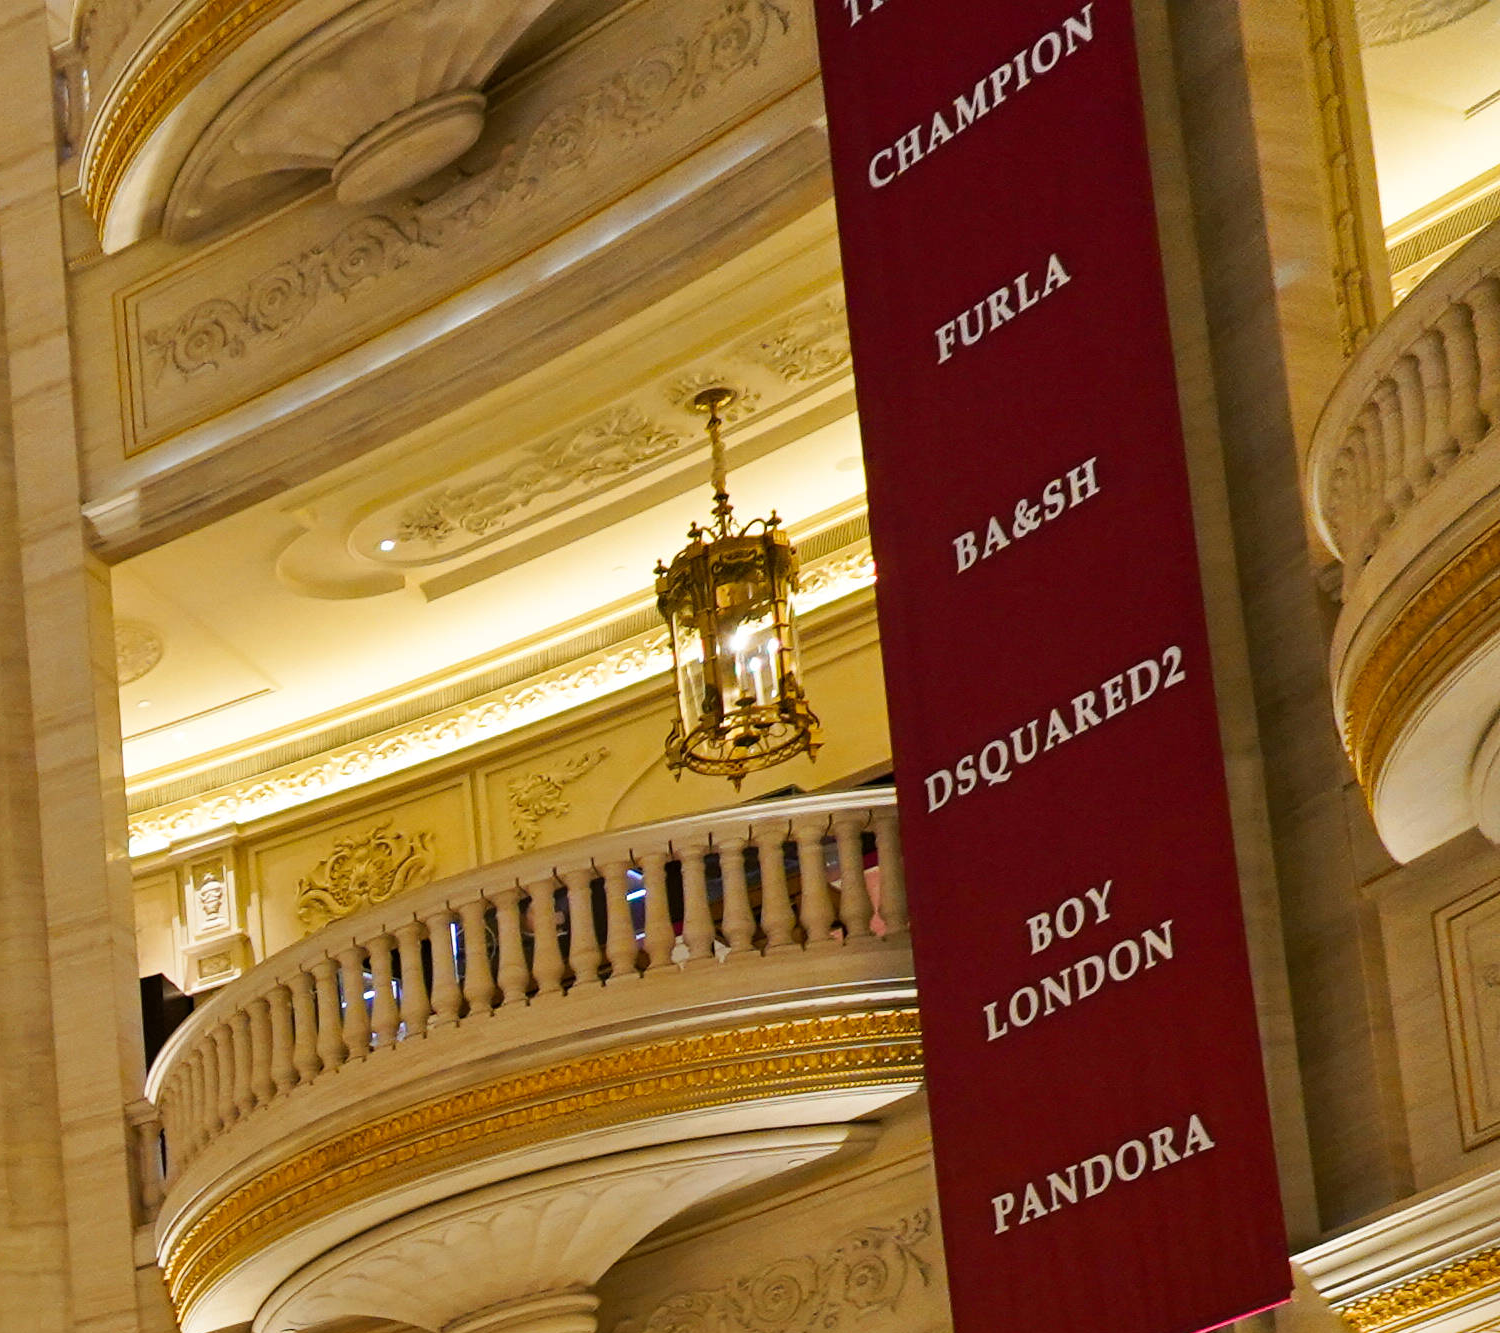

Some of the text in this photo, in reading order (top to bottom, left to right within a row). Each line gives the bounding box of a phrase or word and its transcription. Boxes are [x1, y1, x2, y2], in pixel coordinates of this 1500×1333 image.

[869, 5, 1093, 188] CHAMPION
[934, 254, 1071, 363] FURLA
[952, 456, 1100, 574] BA&SH
[924, 645, 1185, 813] DSQUARED2
[1026, 879, 1112, 955] BOY
[983, 919, 1173, 1042] LONDON
[991, 1114, 1215, 1235] PANDORA
